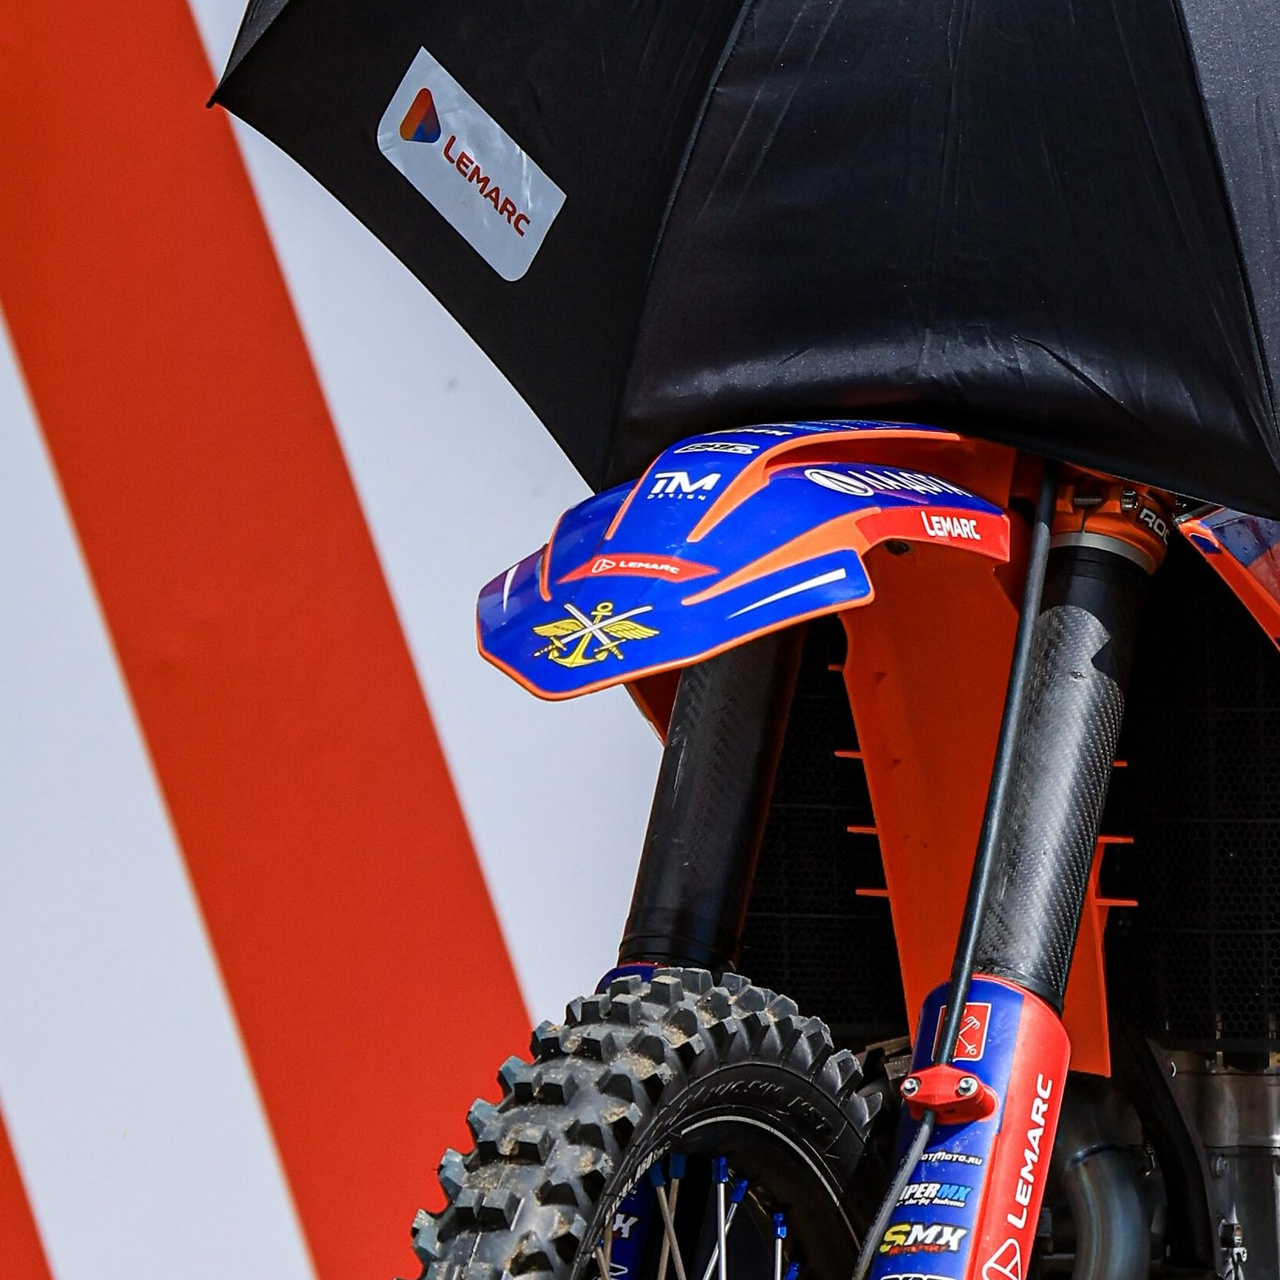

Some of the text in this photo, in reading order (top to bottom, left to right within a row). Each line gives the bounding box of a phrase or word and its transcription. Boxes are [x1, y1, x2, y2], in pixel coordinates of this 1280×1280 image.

[443, 134, 531, 237] LEMARC
[921, 510, 981, 541] LEMARC
[618, 560, 680, 575] LEMARC
[1007, 1073, 1053, 1231] LEMARC
[899, 1182, 973, 1202] IPERMX
[880, 1223, 968, 1253] SMX
